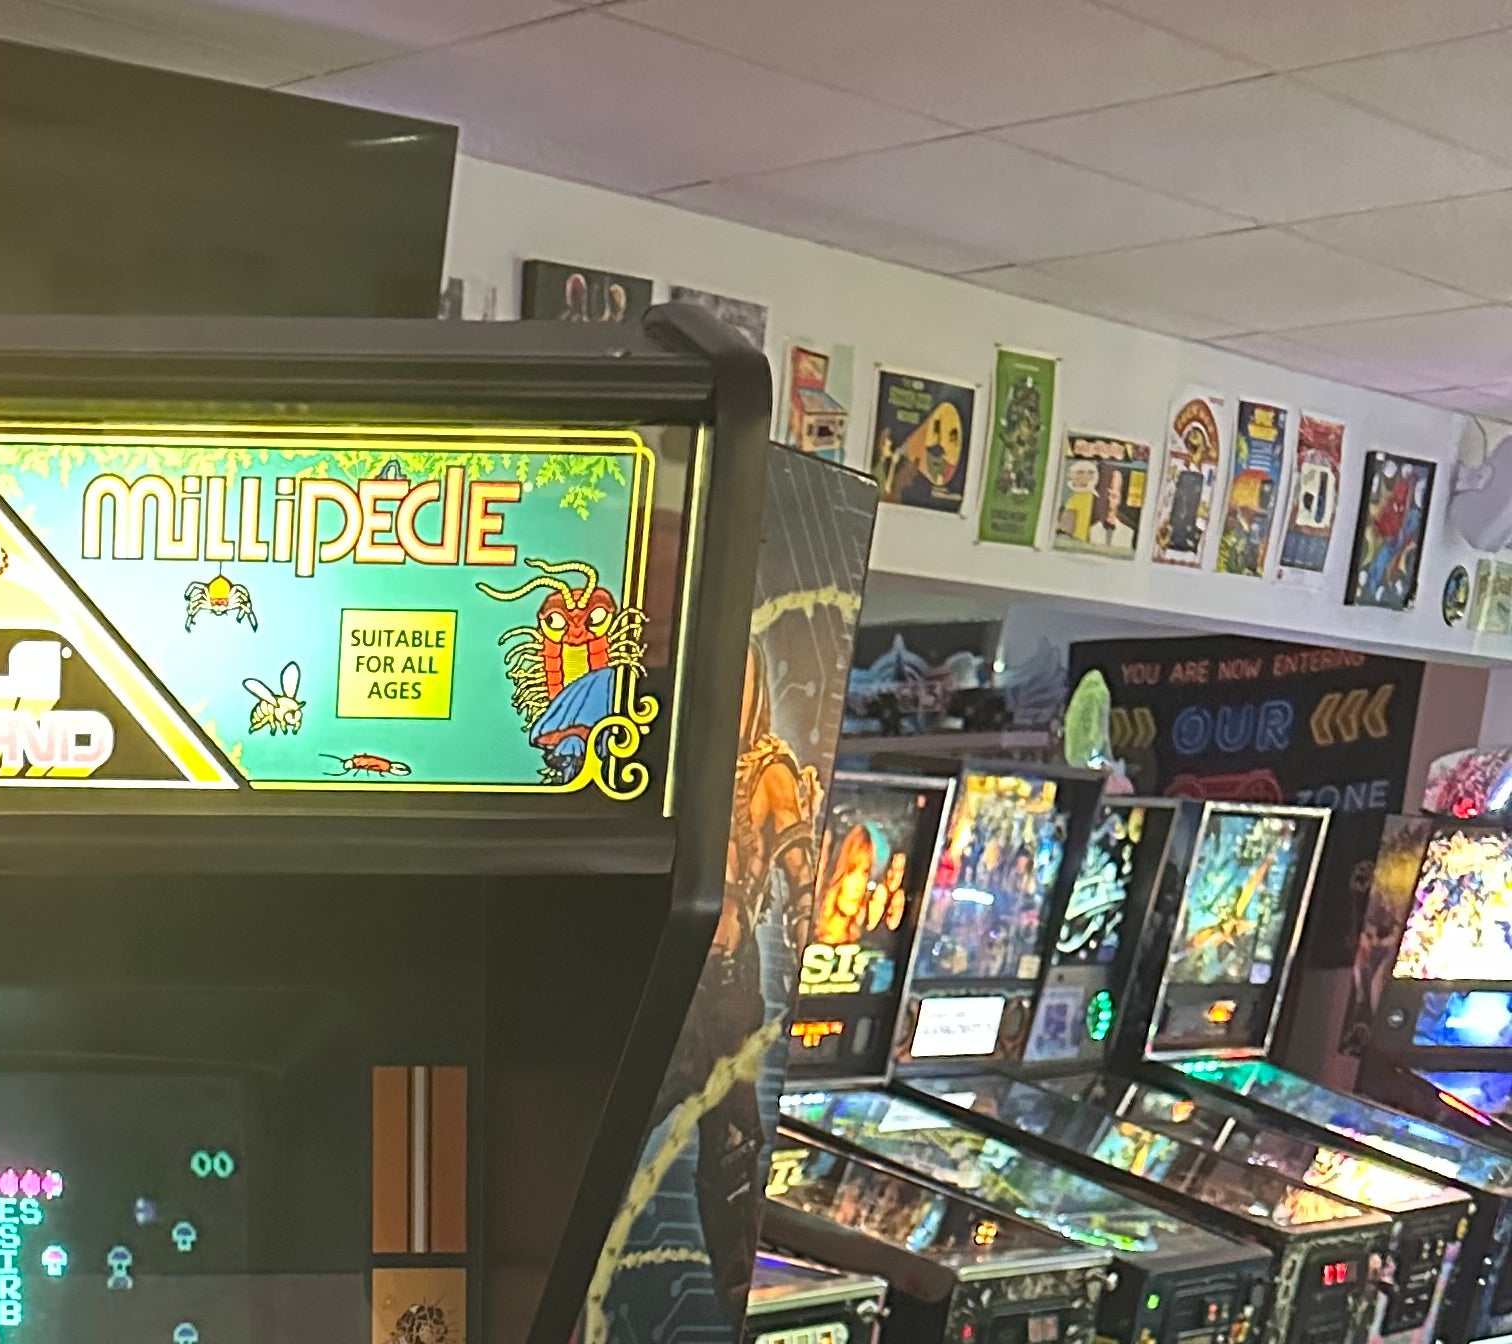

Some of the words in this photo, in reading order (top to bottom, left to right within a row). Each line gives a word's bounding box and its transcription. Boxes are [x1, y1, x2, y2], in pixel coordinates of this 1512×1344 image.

[350, 628, 447, 648] SUITABLE
[355, 655, 395, 673] FOR
[400, 655, 439, 674] ALL
[1121, 662, 1160, 685] YOU
[1168, 659, 1210, 684] ARE
[1217, 657, 1262, 681] NOW
[1273, 648, 1366, 677] ENTERING
[367, 681, 423, 699] AGES
[1172, 698, 1294, 755] OUR
[190, 1150, 235, 1179] 00
